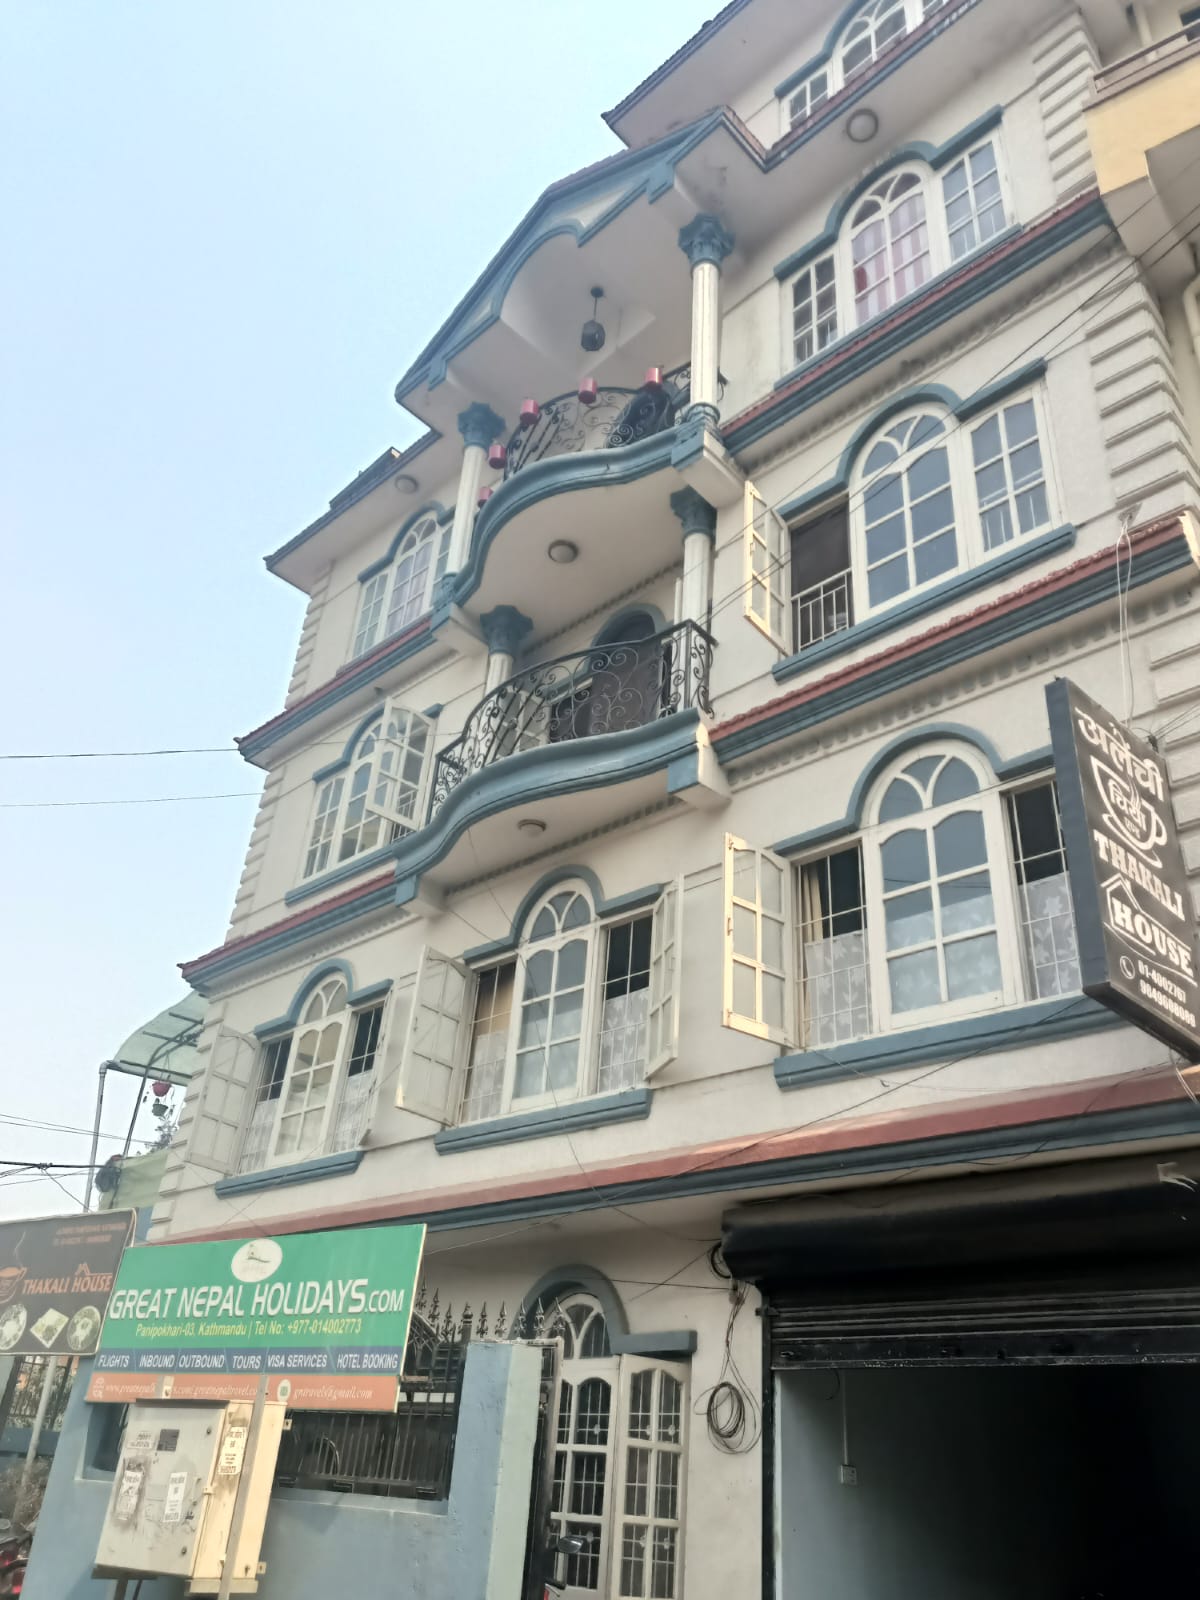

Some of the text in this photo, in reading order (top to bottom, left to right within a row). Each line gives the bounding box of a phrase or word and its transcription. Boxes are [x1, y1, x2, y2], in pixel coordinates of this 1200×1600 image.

[1093, 829, 1185, 922] THAKALI
[1111, 896, 1194, 978] HOUSE
[22, 1274, 113, 1295] THAKALI HOUSE
[109, 1278, 405, 1319] GREAT NEPAL HOLIDAYS.COM
[198, 1321, 247, 1336] Kathmandu
[254, 1320, 267, 1335] Tel
[269, 1320, 285, 1335] No:
[98, 1353, 398, 1369] FLIGHTS INBOUND OUTBOUND TOURS VISA SERVICES HOTEL BOOKING
